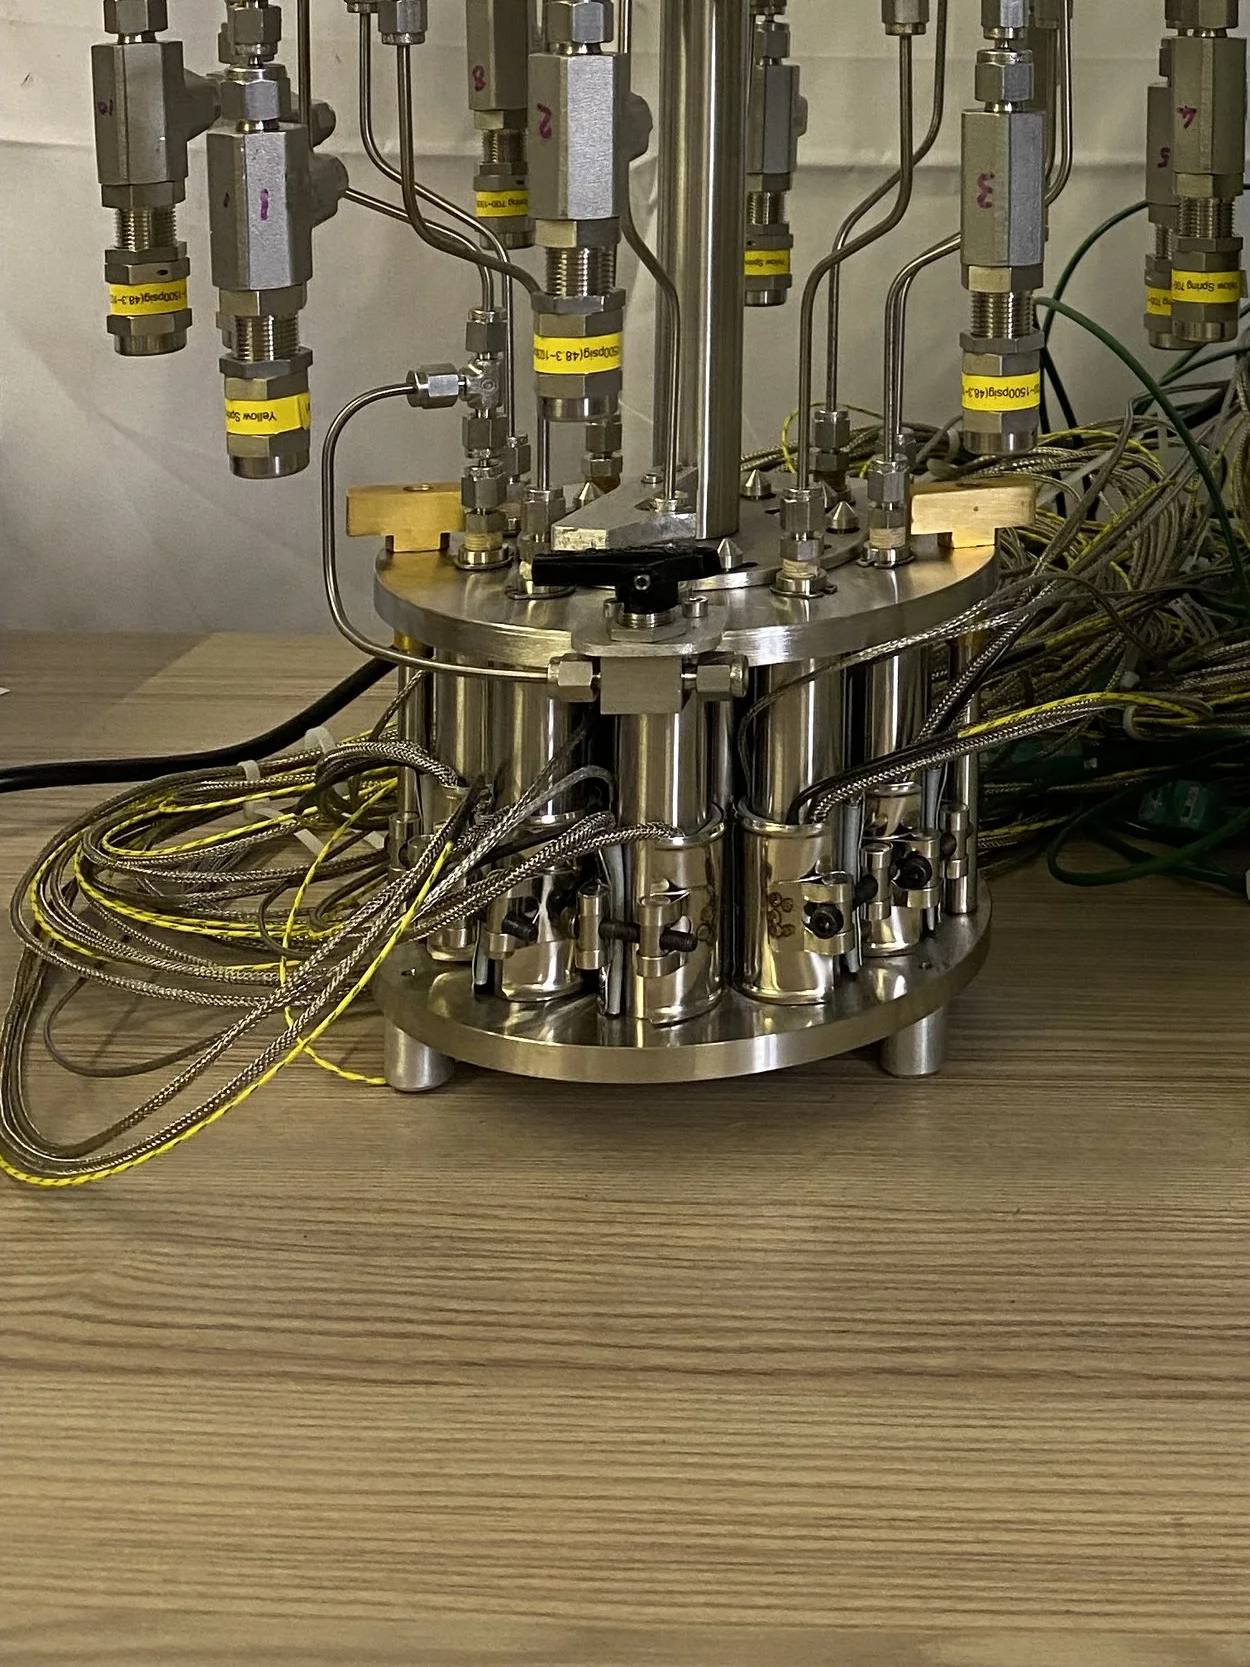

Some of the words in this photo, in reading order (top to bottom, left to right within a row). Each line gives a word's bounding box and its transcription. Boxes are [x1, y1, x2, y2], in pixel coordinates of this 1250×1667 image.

[536, 102, 552, 139] 2
[977, 171, 996, 208] 3
[243, 411, 277, 422] Yellow
